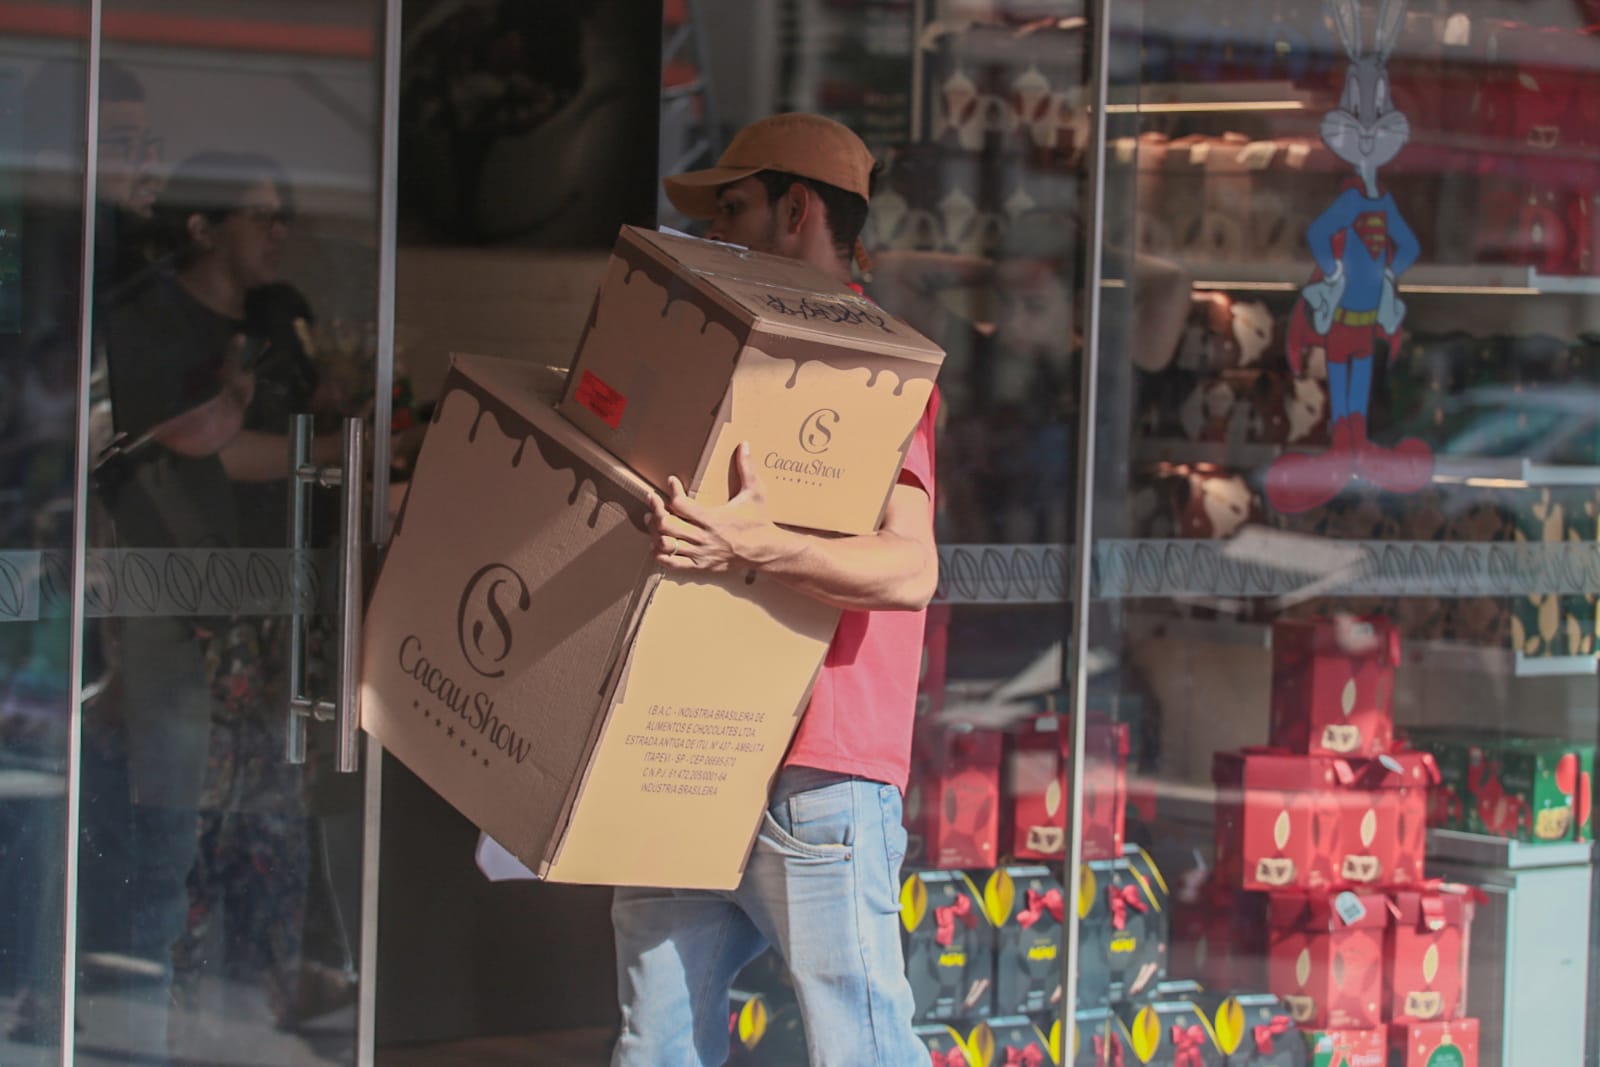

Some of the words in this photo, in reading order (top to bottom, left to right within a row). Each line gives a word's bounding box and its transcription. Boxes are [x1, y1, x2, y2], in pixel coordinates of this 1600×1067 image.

[714, 709, 754, 722] BRASILEIRA
[754, 711, 766, 723] DE
[646, 720, 686, 733] ALIMENTOS
[691, 723, 738, 737] CHOCOLATES
[625, 734, 659, 747] ESTRADA
[658, 736, 686, 749] ANTIGA
[685, 738, 697, 750] DE
[675, 753, 686, 764] SP
[689, 754, 704, 765] CEP
[677, 784, 718, 796] BRASILEIRA
